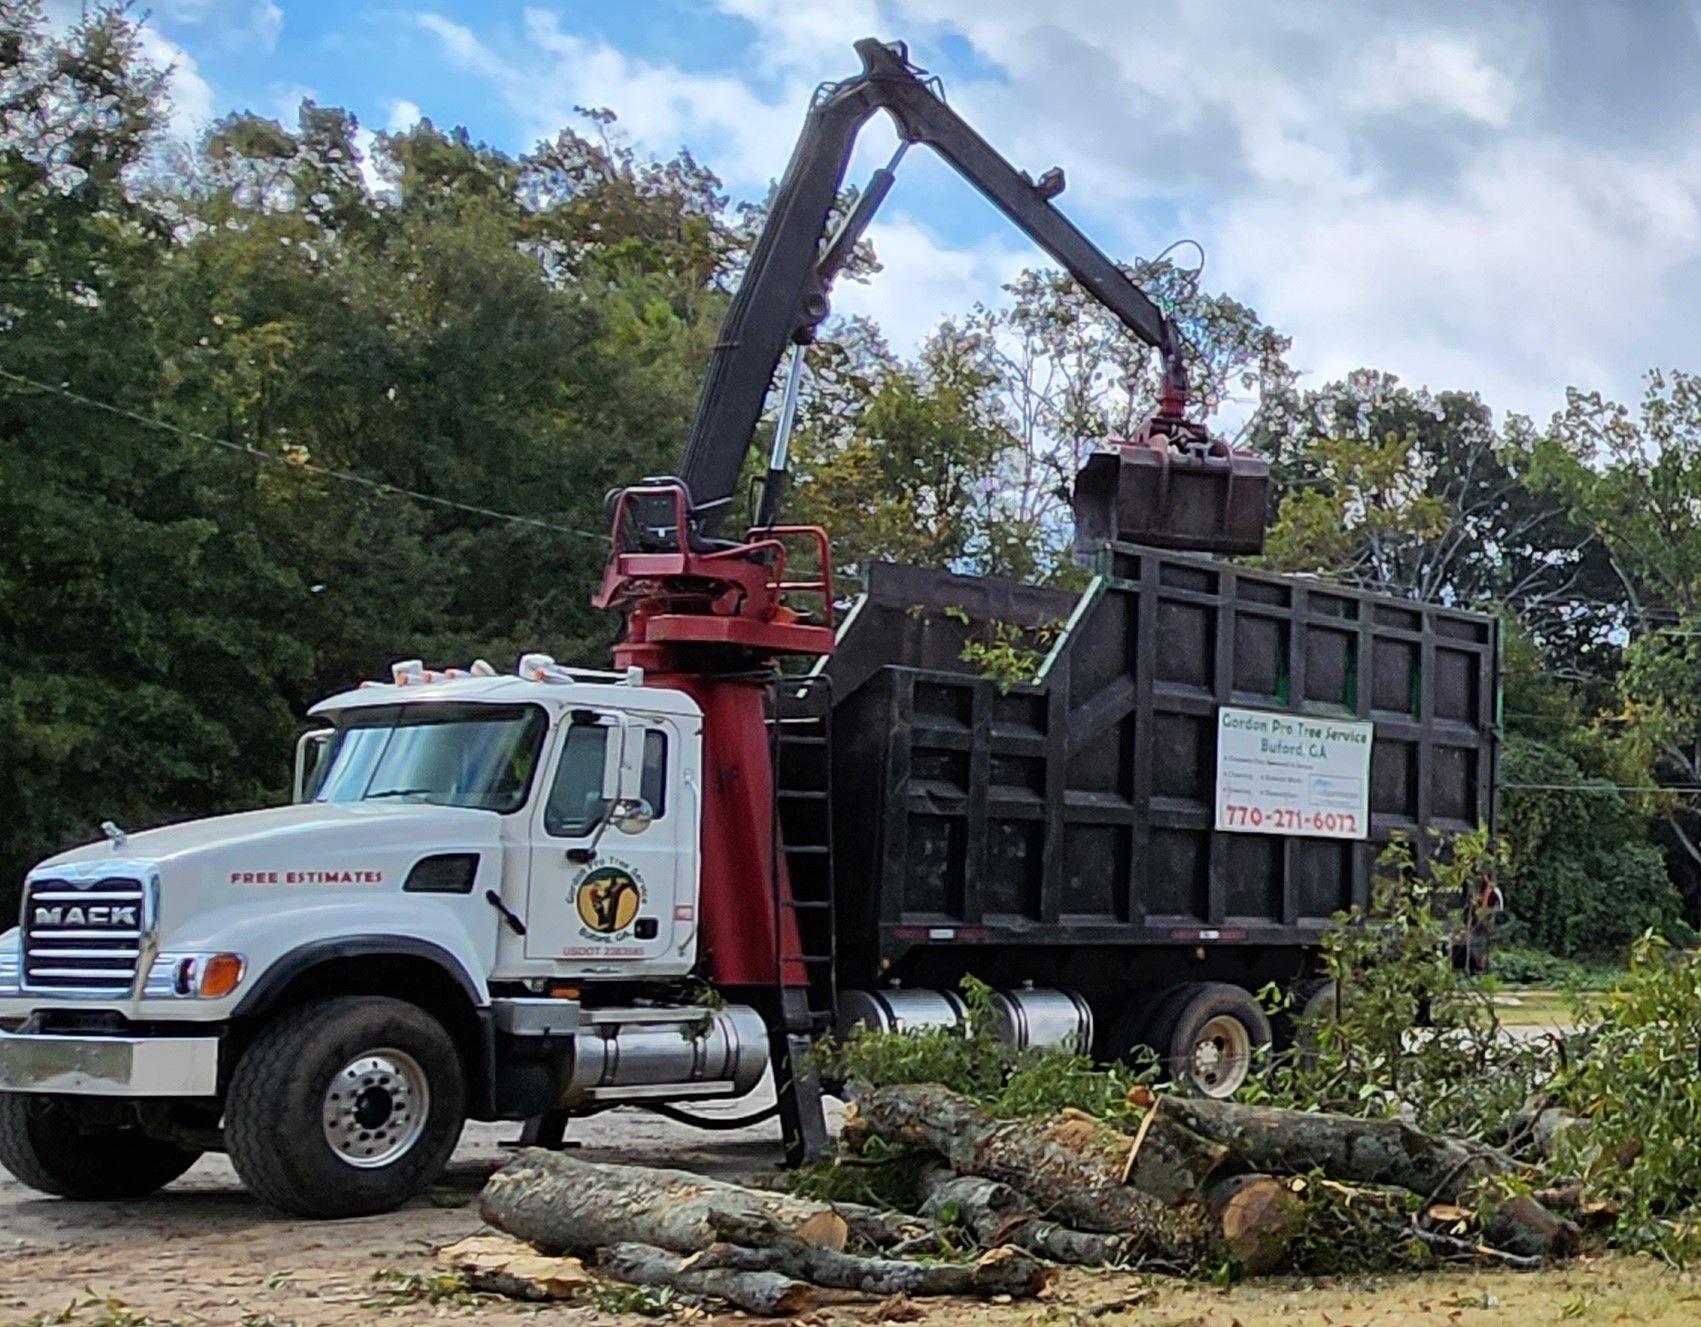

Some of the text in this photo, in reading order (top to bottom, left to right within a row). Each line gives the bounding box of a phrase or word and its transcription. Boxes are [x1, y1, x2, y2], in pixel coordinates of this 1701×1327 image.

[1222, 713, 1367, 744] Gordon Pro Tree Service
[1309, 743, 1327, 759] GA
[1226, 804, 1357, 833] 770-271-6072
[230, 871, 383, 884] FREE ESTIMATES
[34, 906, 137, 926] MACK
[563, 947, 601, 956] USDOT
